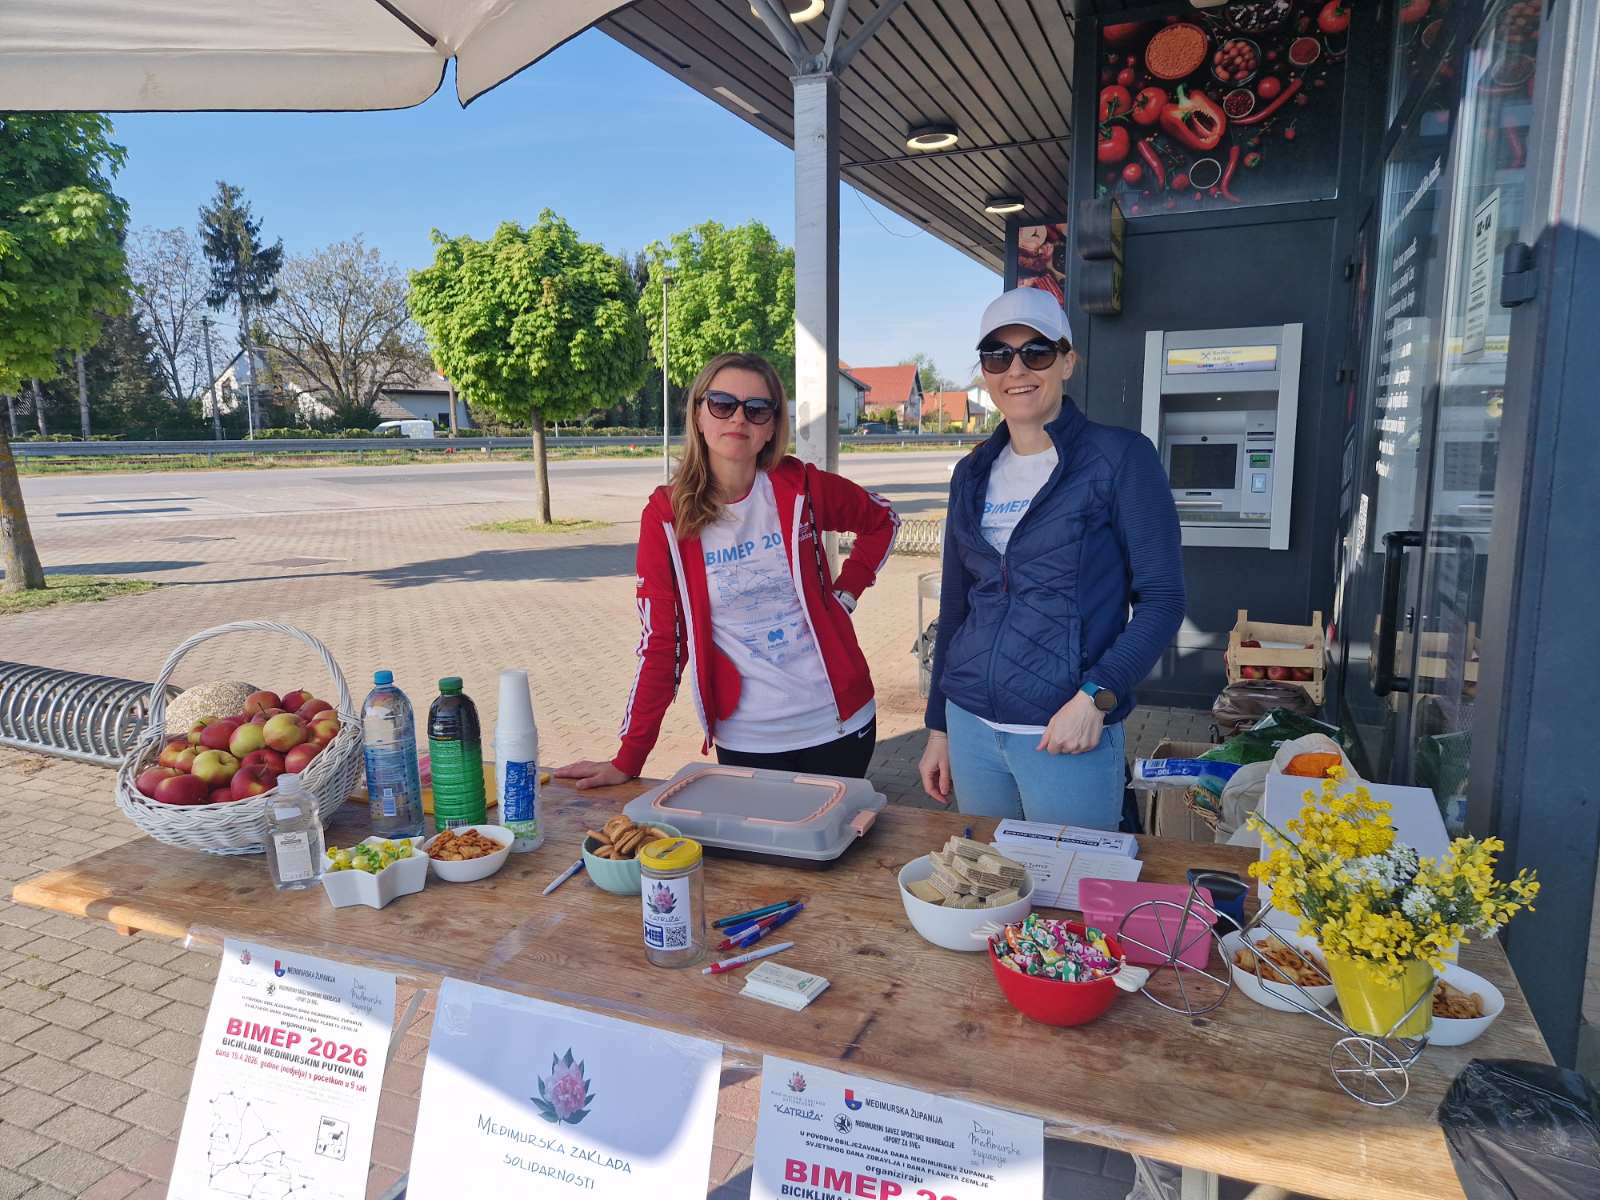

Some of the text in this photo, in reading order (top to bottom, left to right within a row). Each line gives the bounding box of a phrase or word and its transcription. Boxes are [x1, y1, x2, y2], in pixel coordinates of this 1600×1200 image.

[705, 540, 755, 566] BIMEP
[222, 1037, 262, 1054] BICIKLIMA
[321, 1061, 364, 1079] PUTOVIMA
[226, 1017, 368, 1067] BIMEP 2026
[910, 1108, 943, 1124] ŽUPANIJA
[569, 1146, 632, 1174] ZAKLADA
[806, 1132, 833, 1143] POVODU
[890, 1151, 909, 1160] DANA
[503, 1152, 595, 1190] SOLIDARNOSTI
[785, 1158, 902, 1200] BIMEP
[806, 1140, 844, 1154] SVJETSKOG
[846, 1149, 864, 1158] DANA
[866, 1154, 902, 1167] ZDRAVLJA
[907, 1163, 925, 1173] DANA
[927, 1169, 959, 1180] PLANETA
[960, 1176, 989, 1188] ZEMLJE
[865, 1165, 923, 1184] organiziraju
